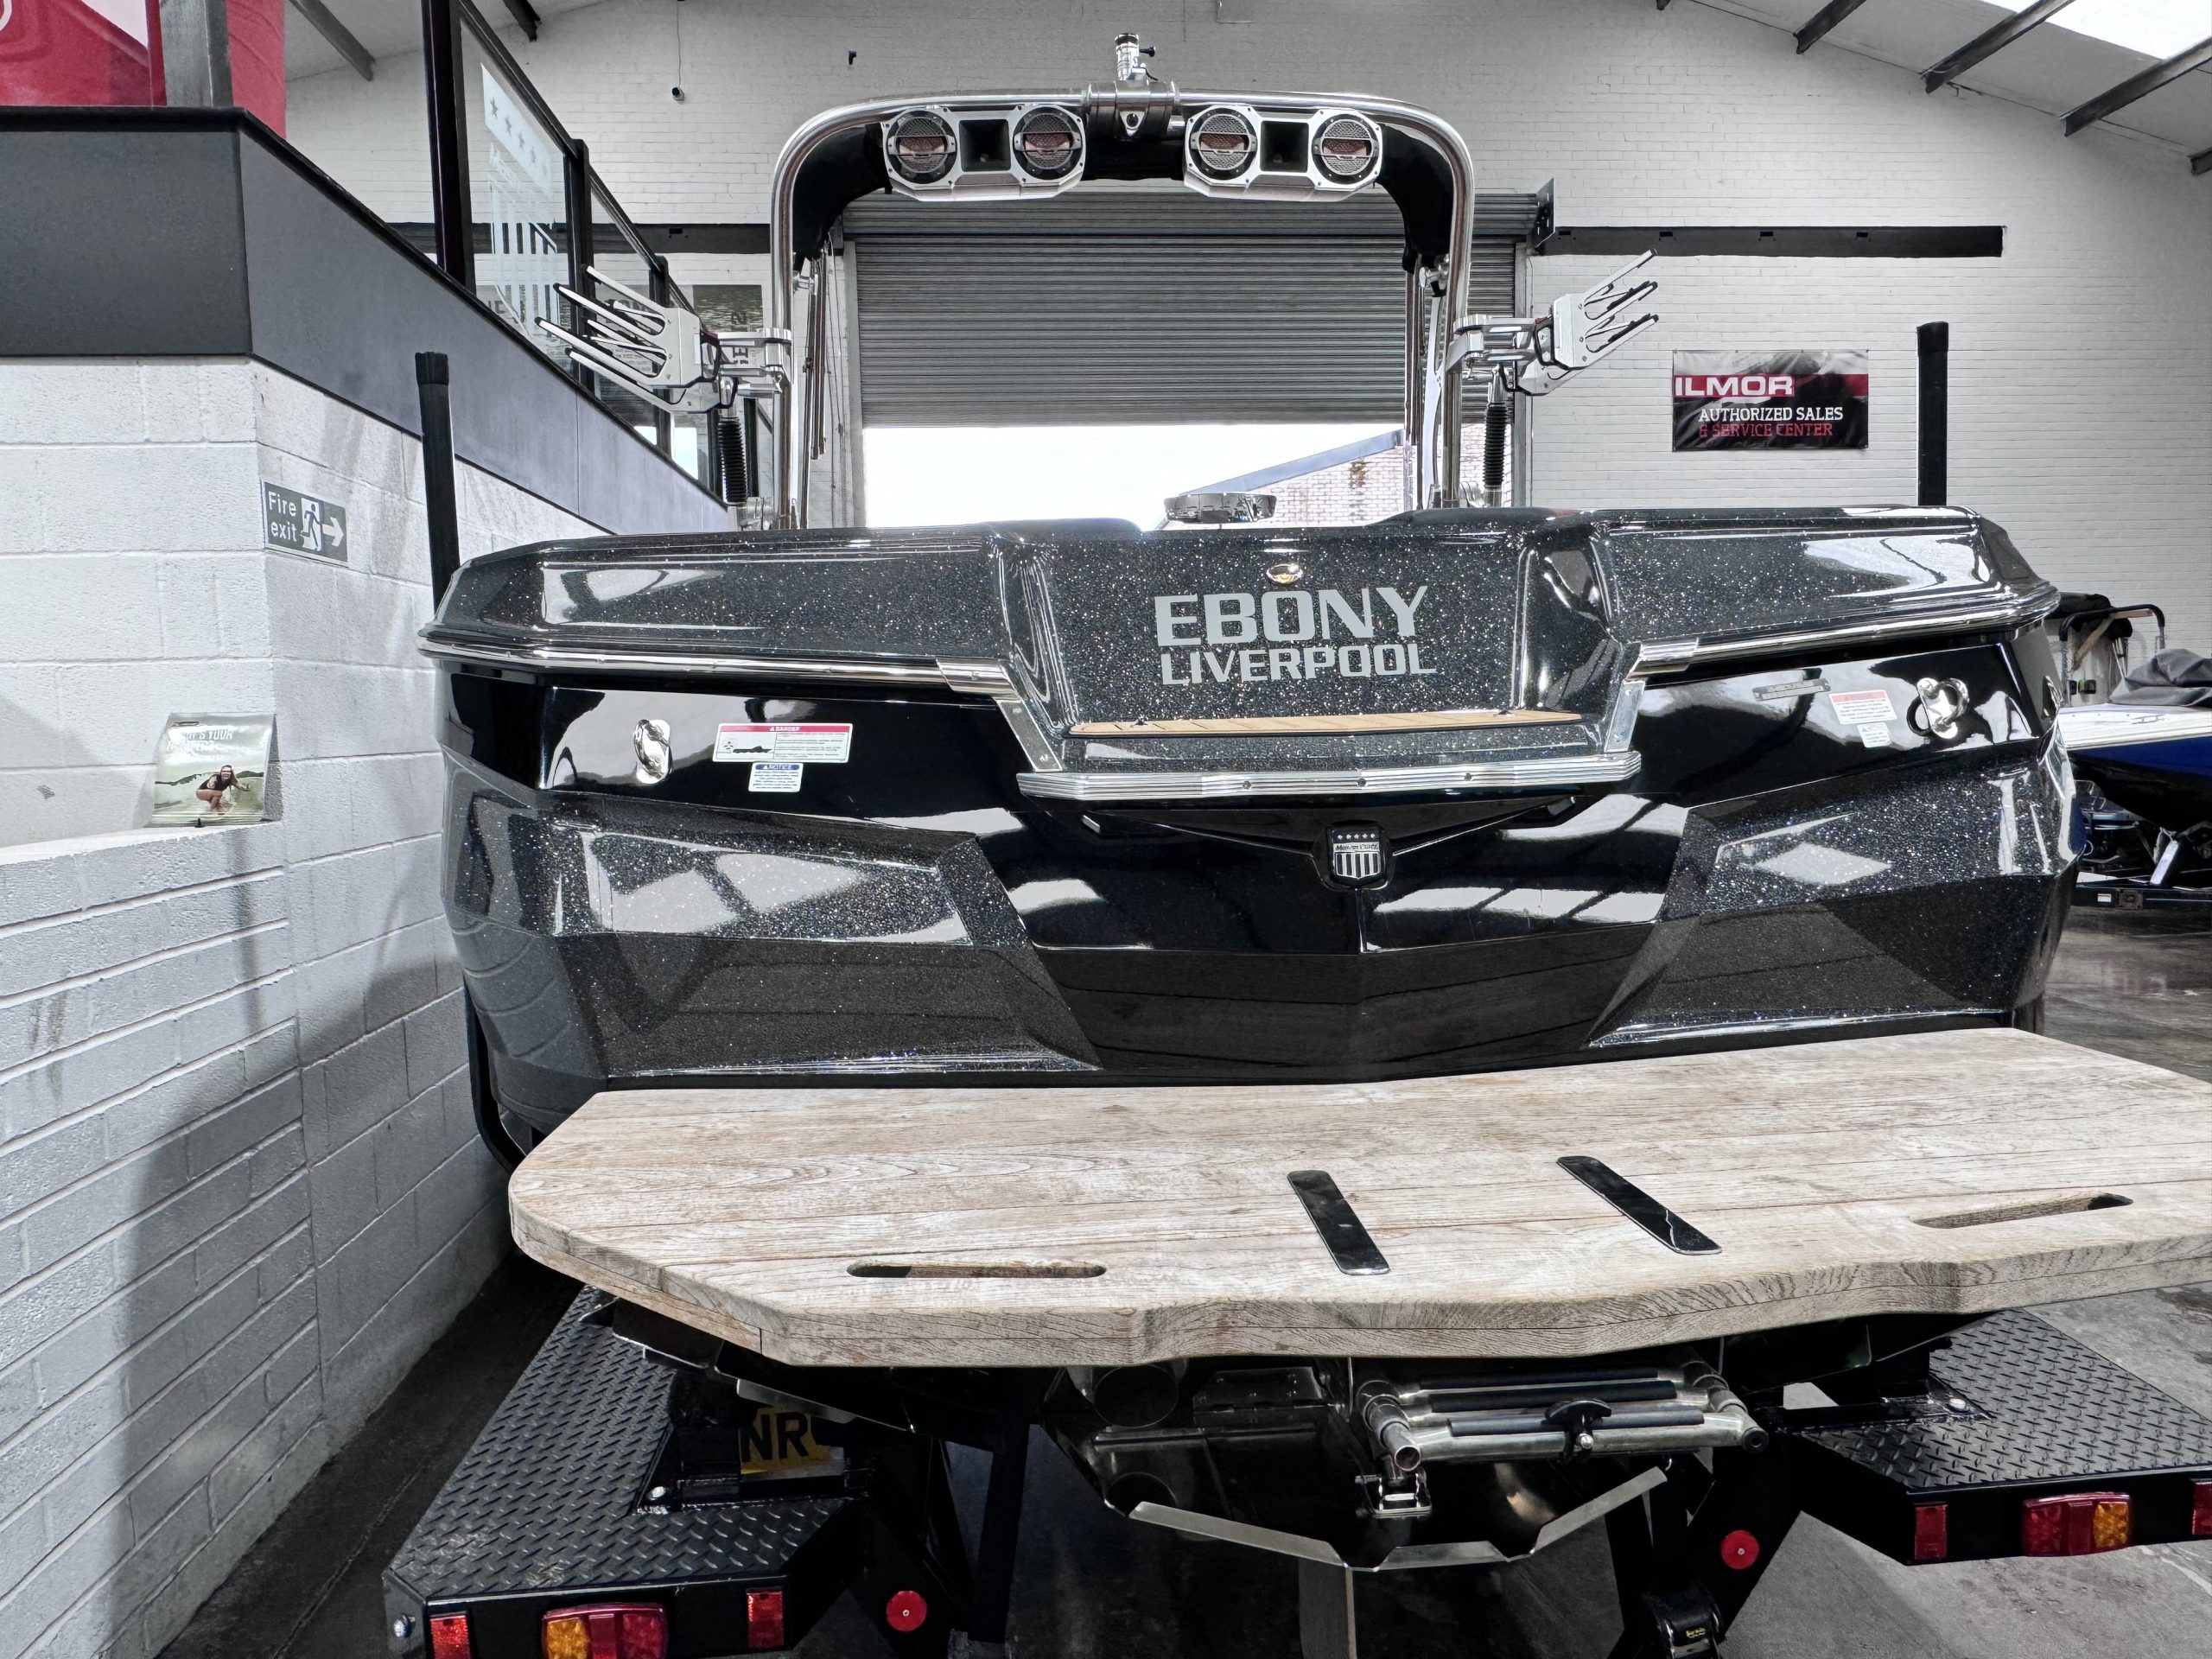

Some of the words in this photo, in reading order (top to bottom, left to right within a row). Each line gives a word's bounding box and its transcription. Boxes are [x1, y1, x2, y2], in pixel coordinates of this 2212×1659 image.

[1675, 375, 1794, 397] ILMOR
[1698, 407, 1793, 422] AUTHORIZED
[1796, 406, 1843, 421] SALES
[1712, 423, 1771, 437] SERVICE
[1776, 423, 1833, 437] CENTER
[268, 490, 297, 517] Fire
[270, 521, 297, 542] exit
[1154, 585, 1428, 647] EBONY
[1160, 643, 1437, 685] LIVERPOOL
